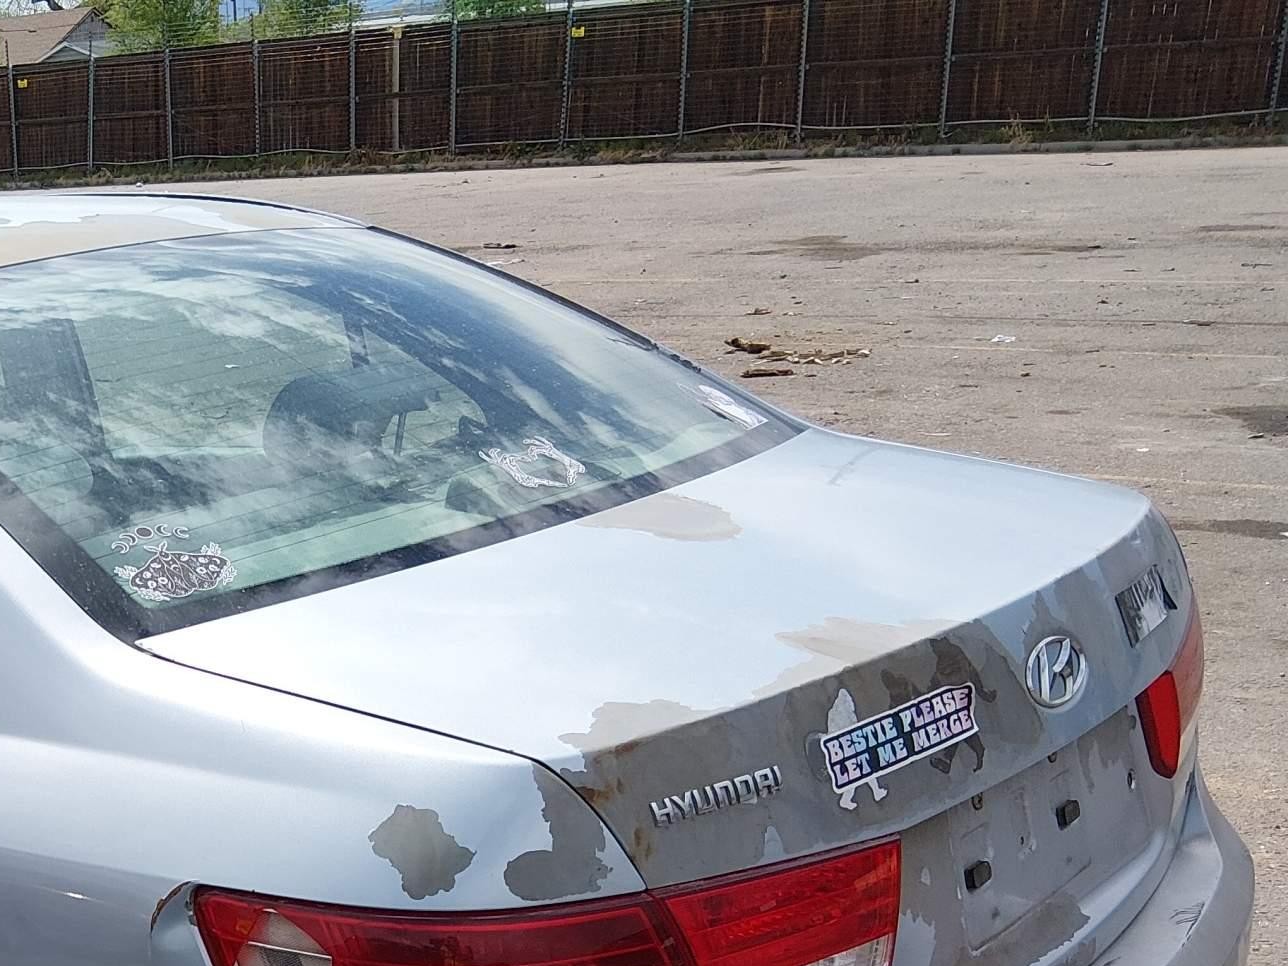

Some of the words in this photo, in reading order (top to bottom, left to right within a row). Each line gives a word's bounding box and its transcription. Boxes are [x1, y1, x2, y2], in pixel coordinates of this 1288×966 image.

[825, 717, 898, 764] BESTIE
[899, 687, 970, 733] PLEASE
[832, 752, 872, 786] LET
[877, 737, 909, 768] ME
[911, 709, 973, 752] MERGE
[649, 765, 784, 826] HYUNDAI
